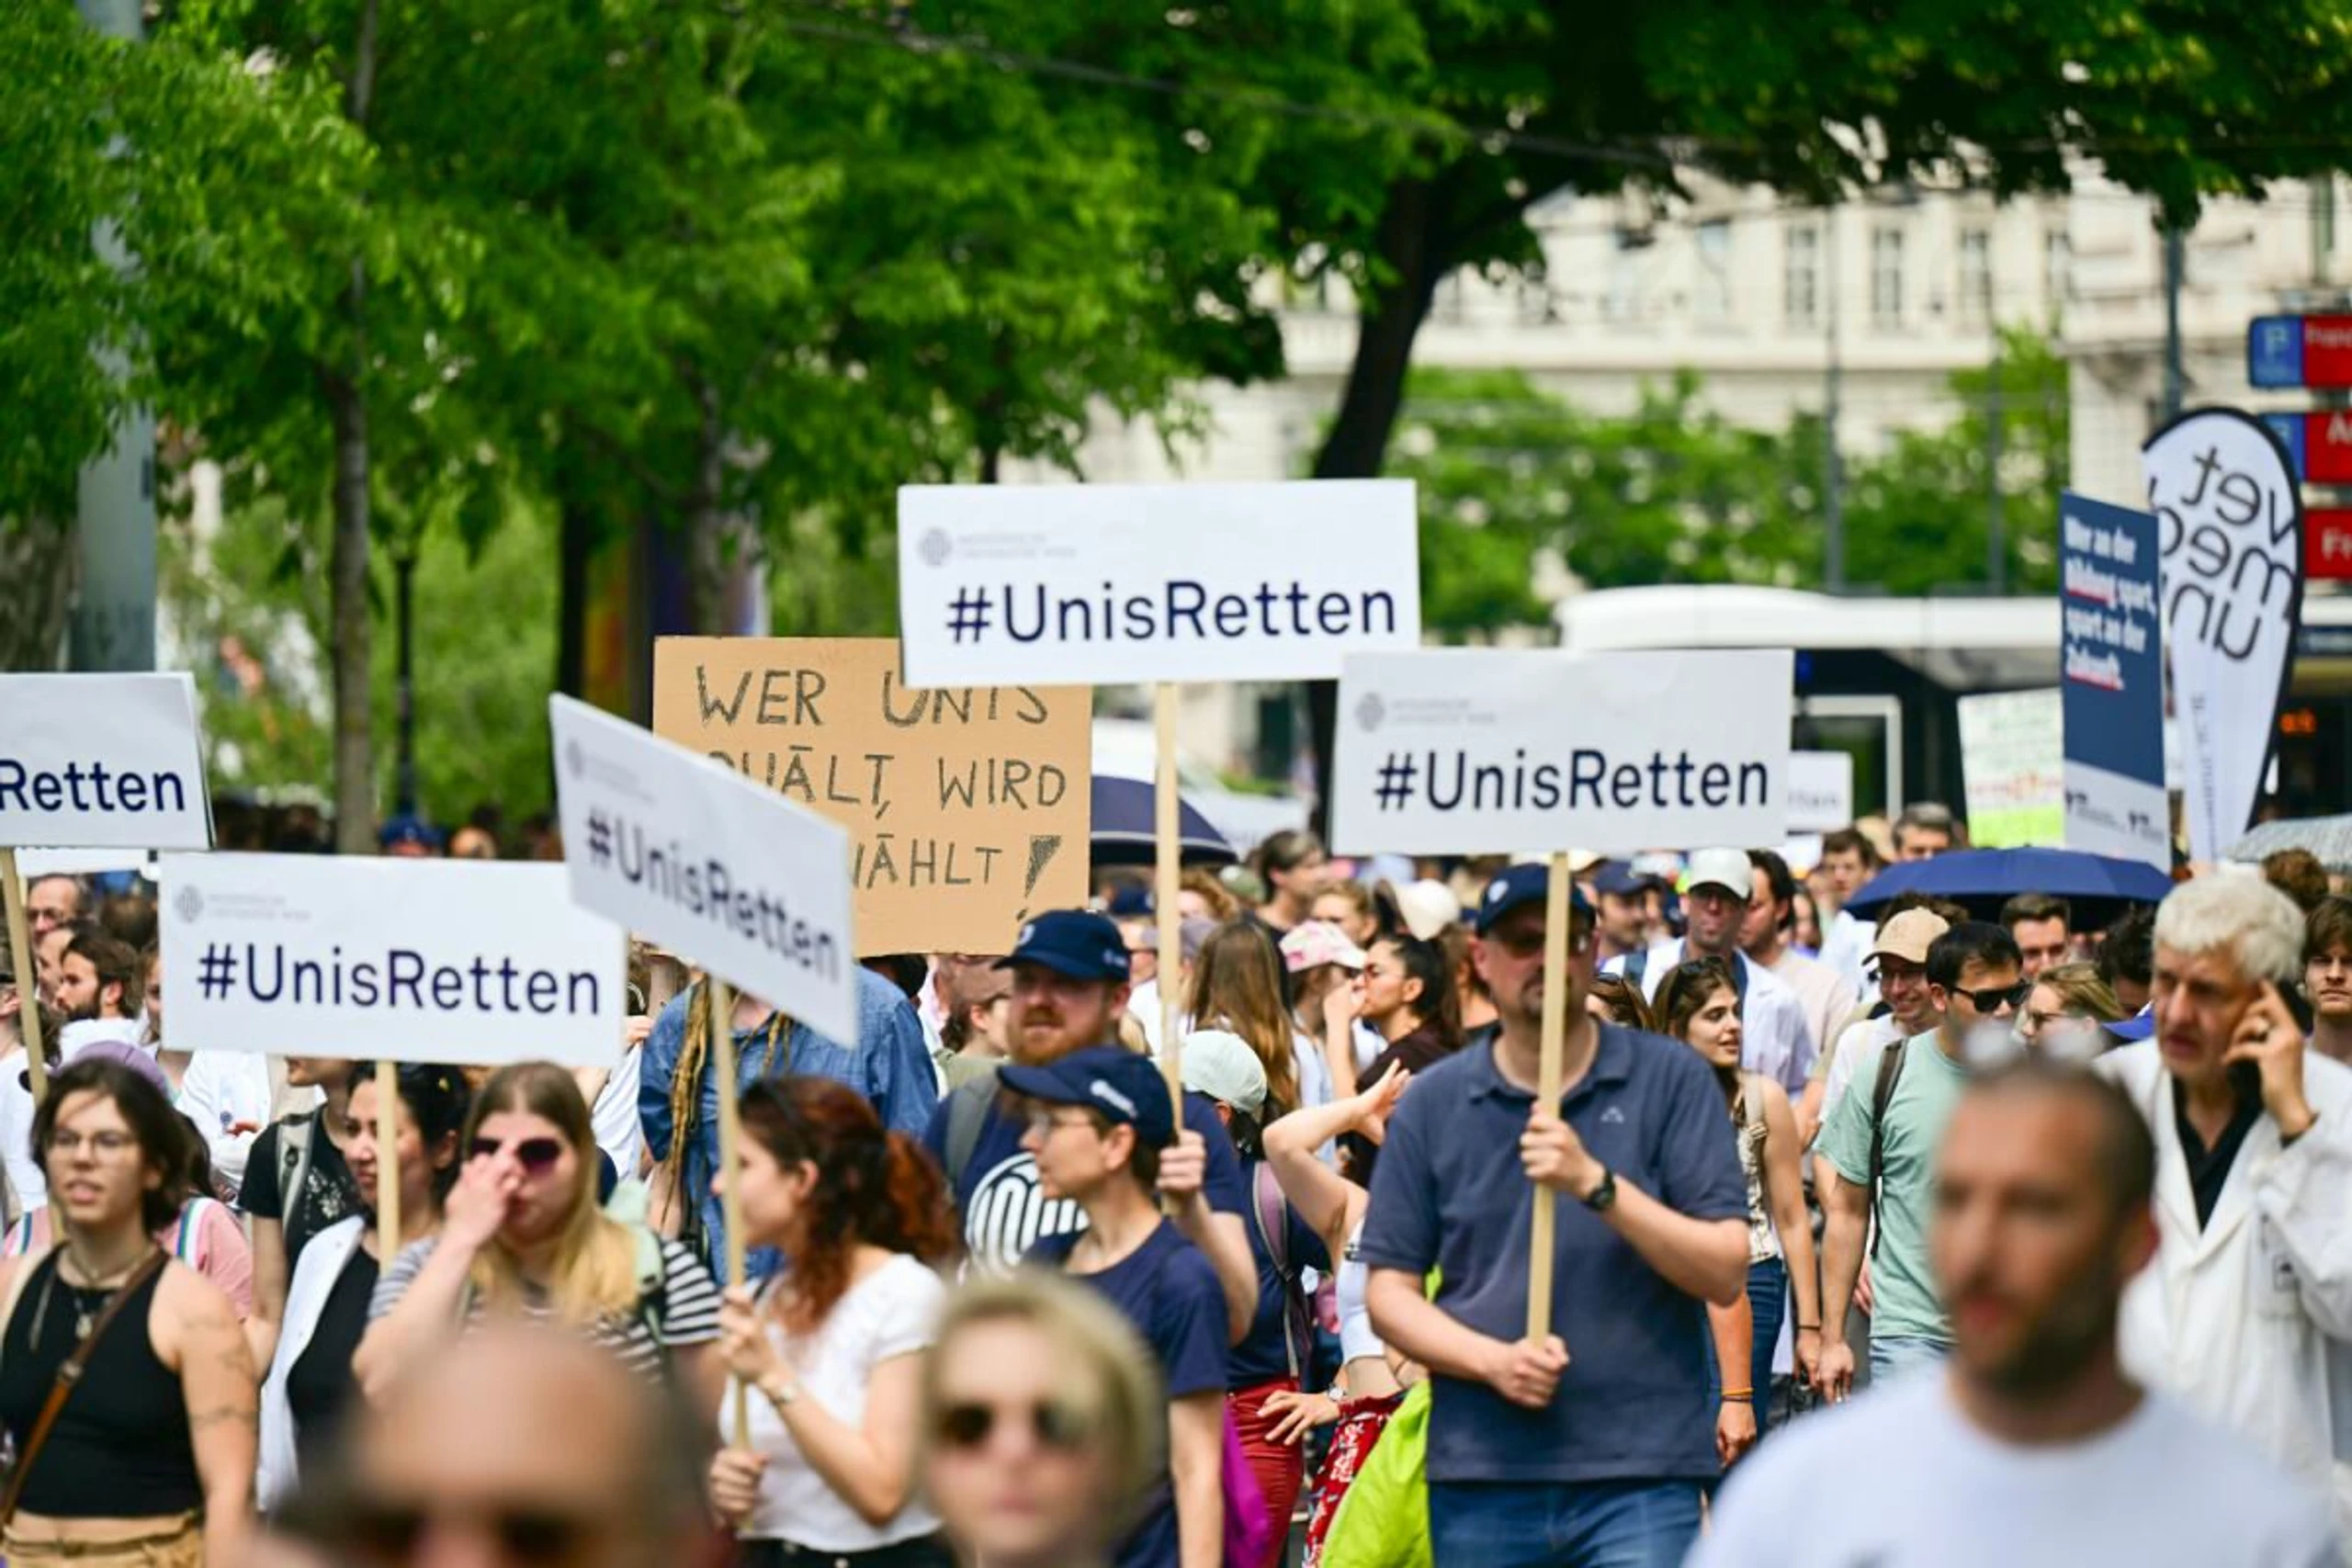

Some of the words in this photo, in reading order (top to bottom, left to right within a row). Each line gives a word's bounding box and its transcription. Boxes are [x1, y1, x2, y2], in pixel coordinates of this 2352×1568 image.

[945, 581, 1396, 644] #UnisRetten
[695, 666, 826, 726] WER
[0, 758, 187, 813] Retten
[938, 757, 1066, 811] WIRD
[1374, 747, 1769, 814] #UnisRetten
[586, 806, 840, 983] #UnisRetten
[197, 942, 600, 1017] #UnisRetten
